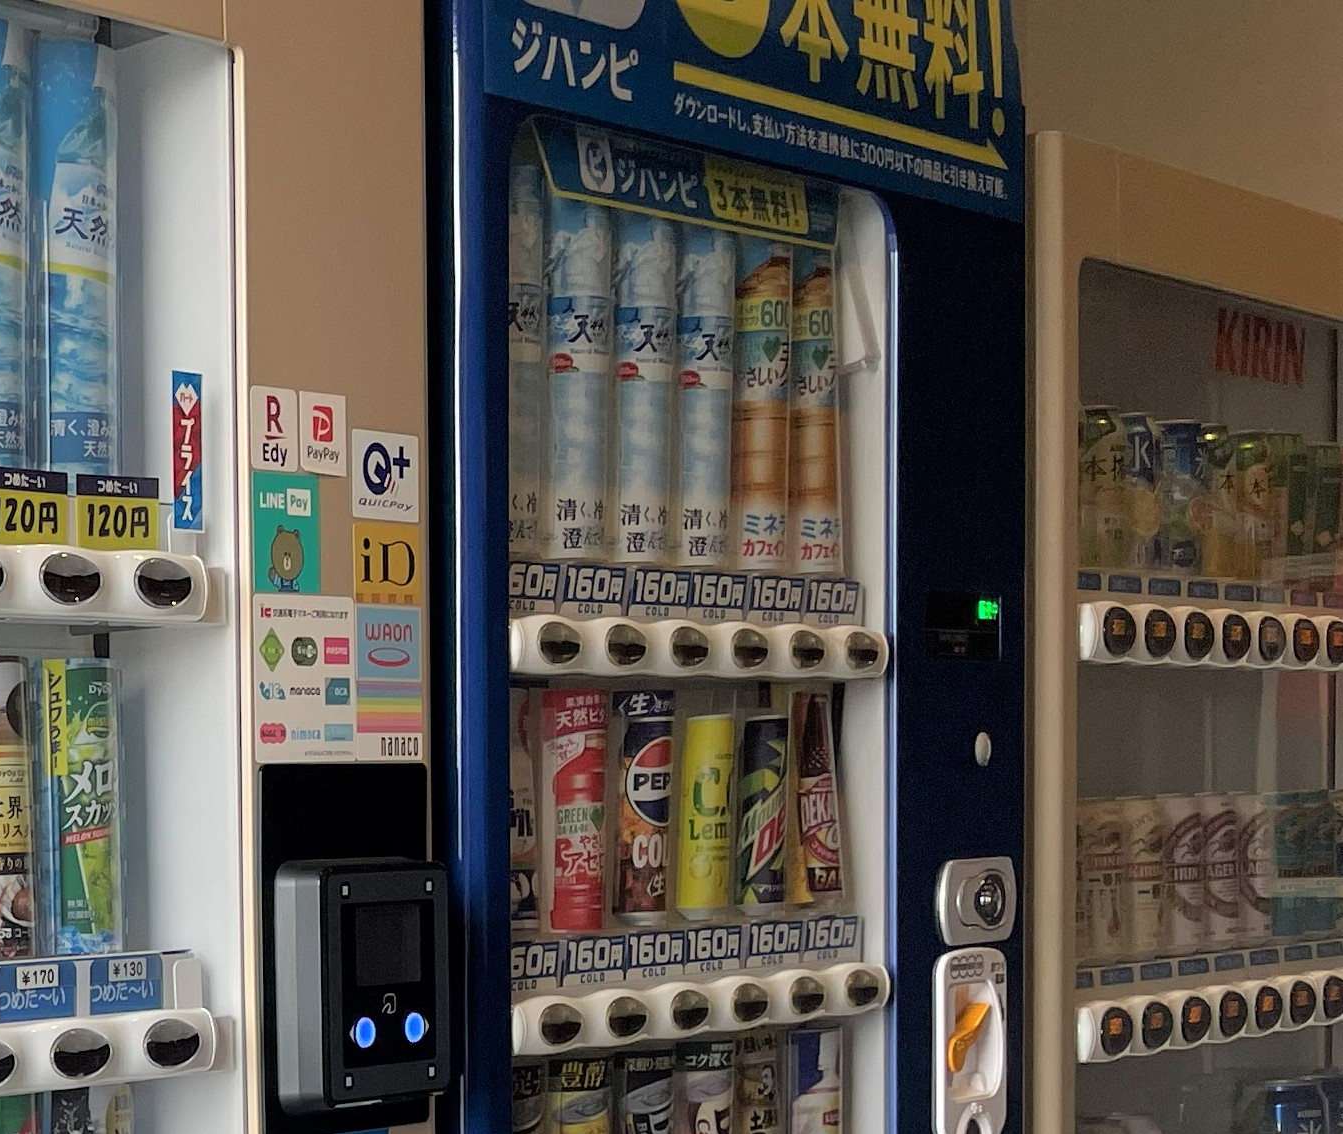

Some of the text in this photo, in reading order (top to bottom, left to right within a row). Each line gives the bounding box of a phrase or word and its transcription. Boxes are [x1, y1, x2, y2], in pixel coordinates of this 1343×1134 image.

[511, 17, 639, 102] ジハンピ
[618, 159, 698, 210] ジハンピ
[1214, 307, 1307, 388] KIRIN
[262, 442, 288, 467] Edy
[307, 445, 340, 464] PayPay
[178, 417, 194, 523] プライス
[259, 491, 308, 511] LINE Pay
[87, 503, 150, 539] 120円
[360, 538, 415, 587] iD
[566, 565, 624, 602] 160円
[693, 574, 744, 605] 160円
[809, 581, 857, 612] 160円
[578, 602, 603, 615] COLD
[702, 608, 726, 619] COLD
[818, 613, 839, 624] COLD
[365, 622, 412, 642] WAON
[290, 687, 321, 696] manaca
[291, 728, 321, 740] nimoca
[381, 737, 419, 756] nanaco
[557, 806, 591, 826] GREEN
[688, 929, 740, 959] 160円
[808, 919, 855, 949] 160円
[568, 939, 624, 971] 160円
[817, 950, 838, 960] COLD
[21, 969, 55, 985] ¥170
[113, 961, 144, 977] ¥130
[642, 967, 666, 978] COLD
